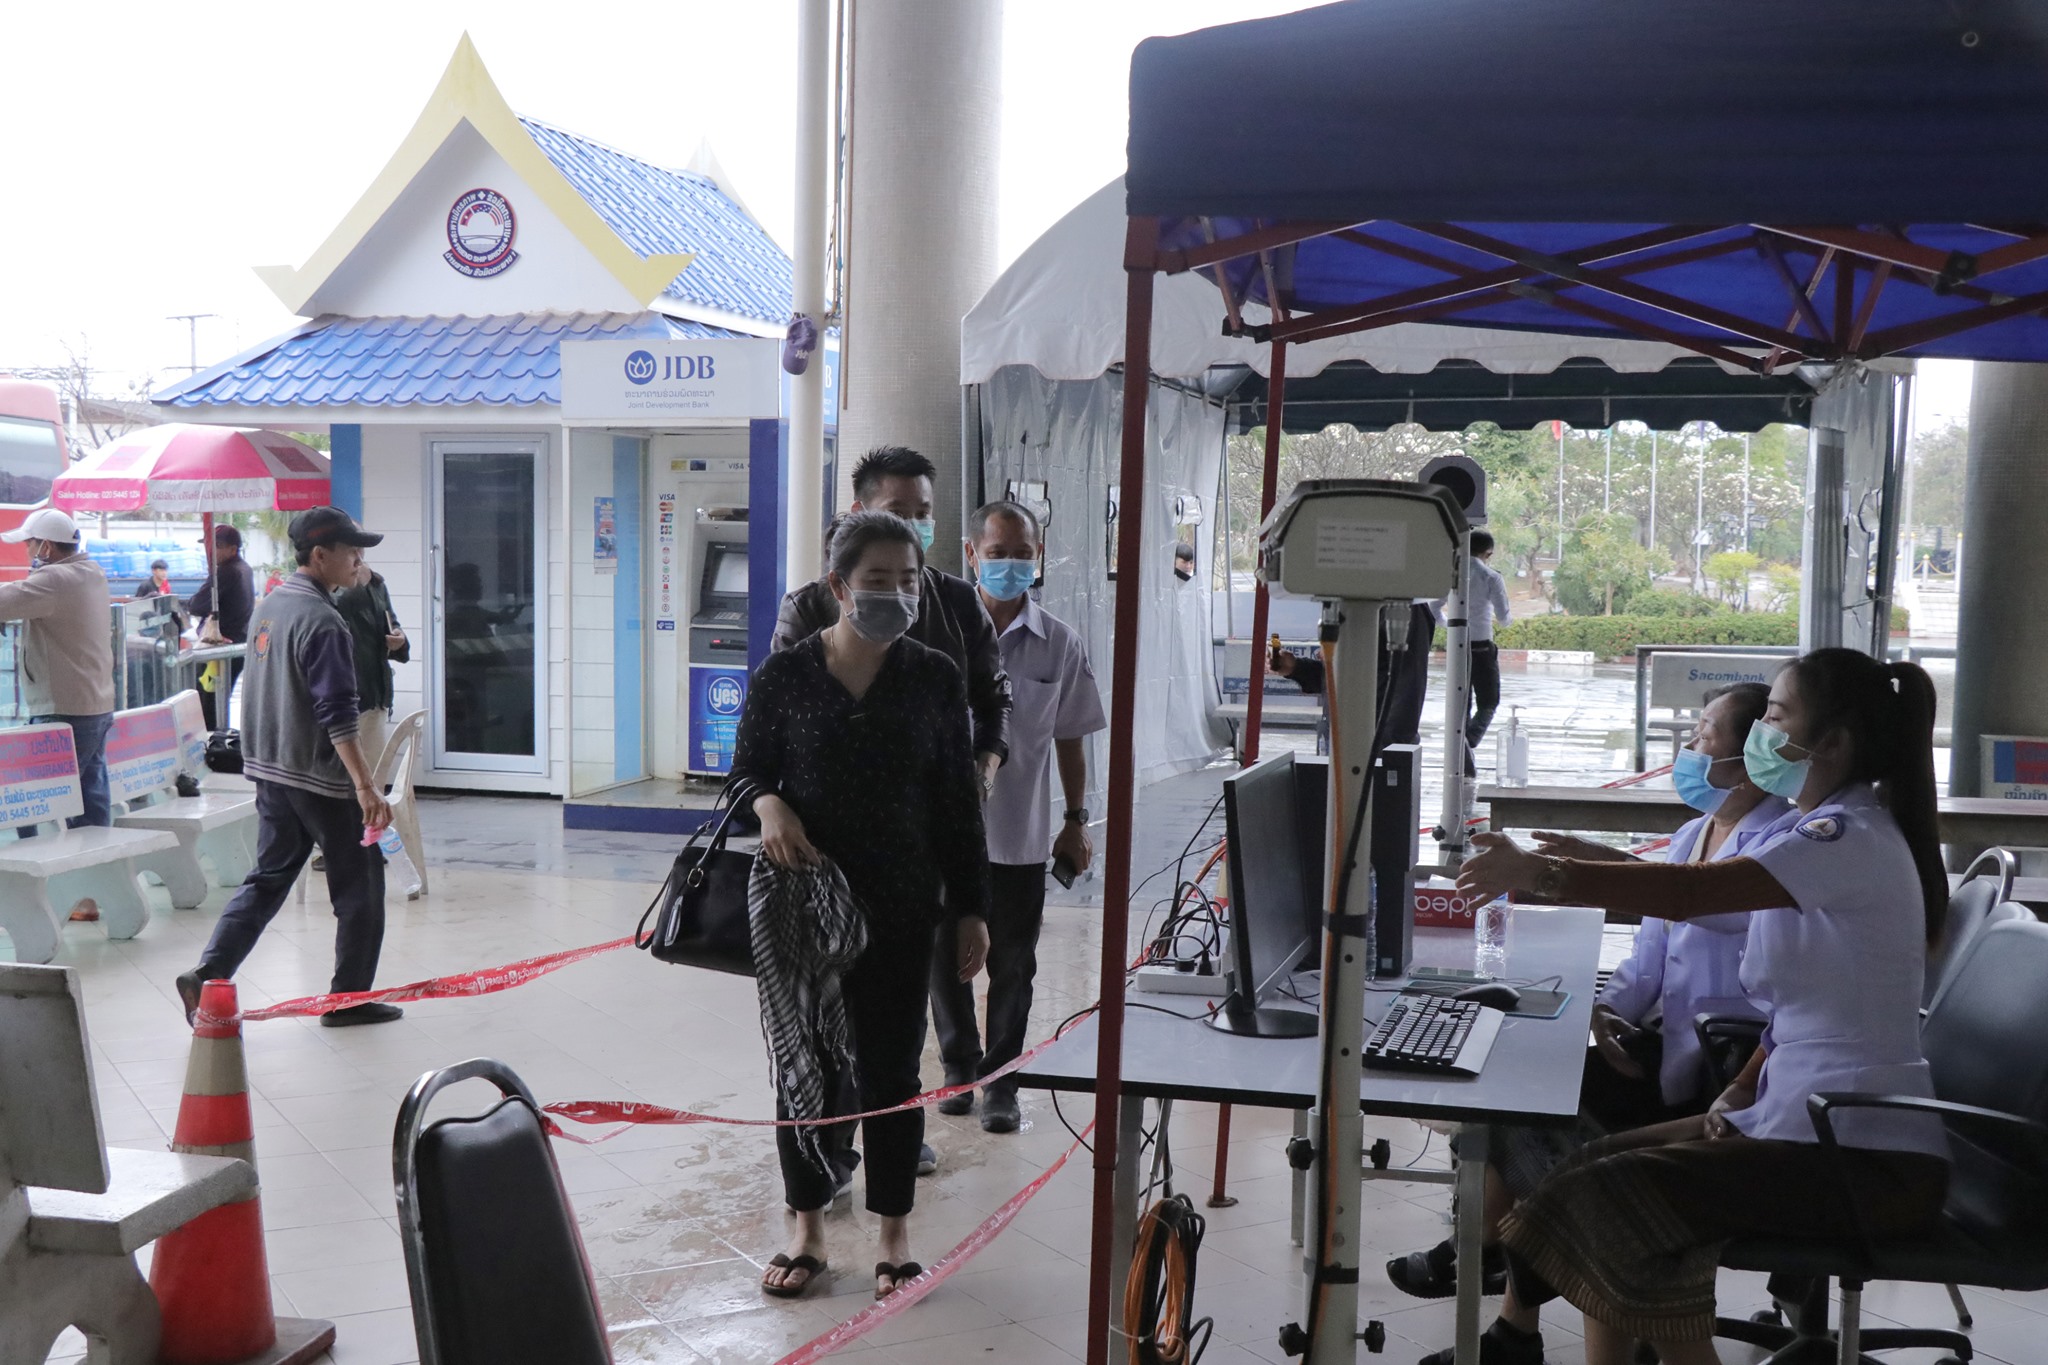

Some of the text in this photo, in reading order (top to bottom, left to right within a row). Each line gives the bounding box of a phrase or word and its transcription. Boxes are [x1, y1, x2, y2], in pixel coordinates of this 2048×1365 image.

[663, 355, 715, 380] JDB
[628, 401, 644, 409] Joint
[645, 401, 690, 410] Development
[58, 490, 75, 499] Sale
[1688, 669, 1766, 683] Sacombank
[713, 688, 739, 708] yes
[25, 760, 76, 779] INSURANCE
[10, 806, 29, 820] 5445
[31, 803, 50, 816] 1234
[485, 975, 508, 985] FRAGILE
